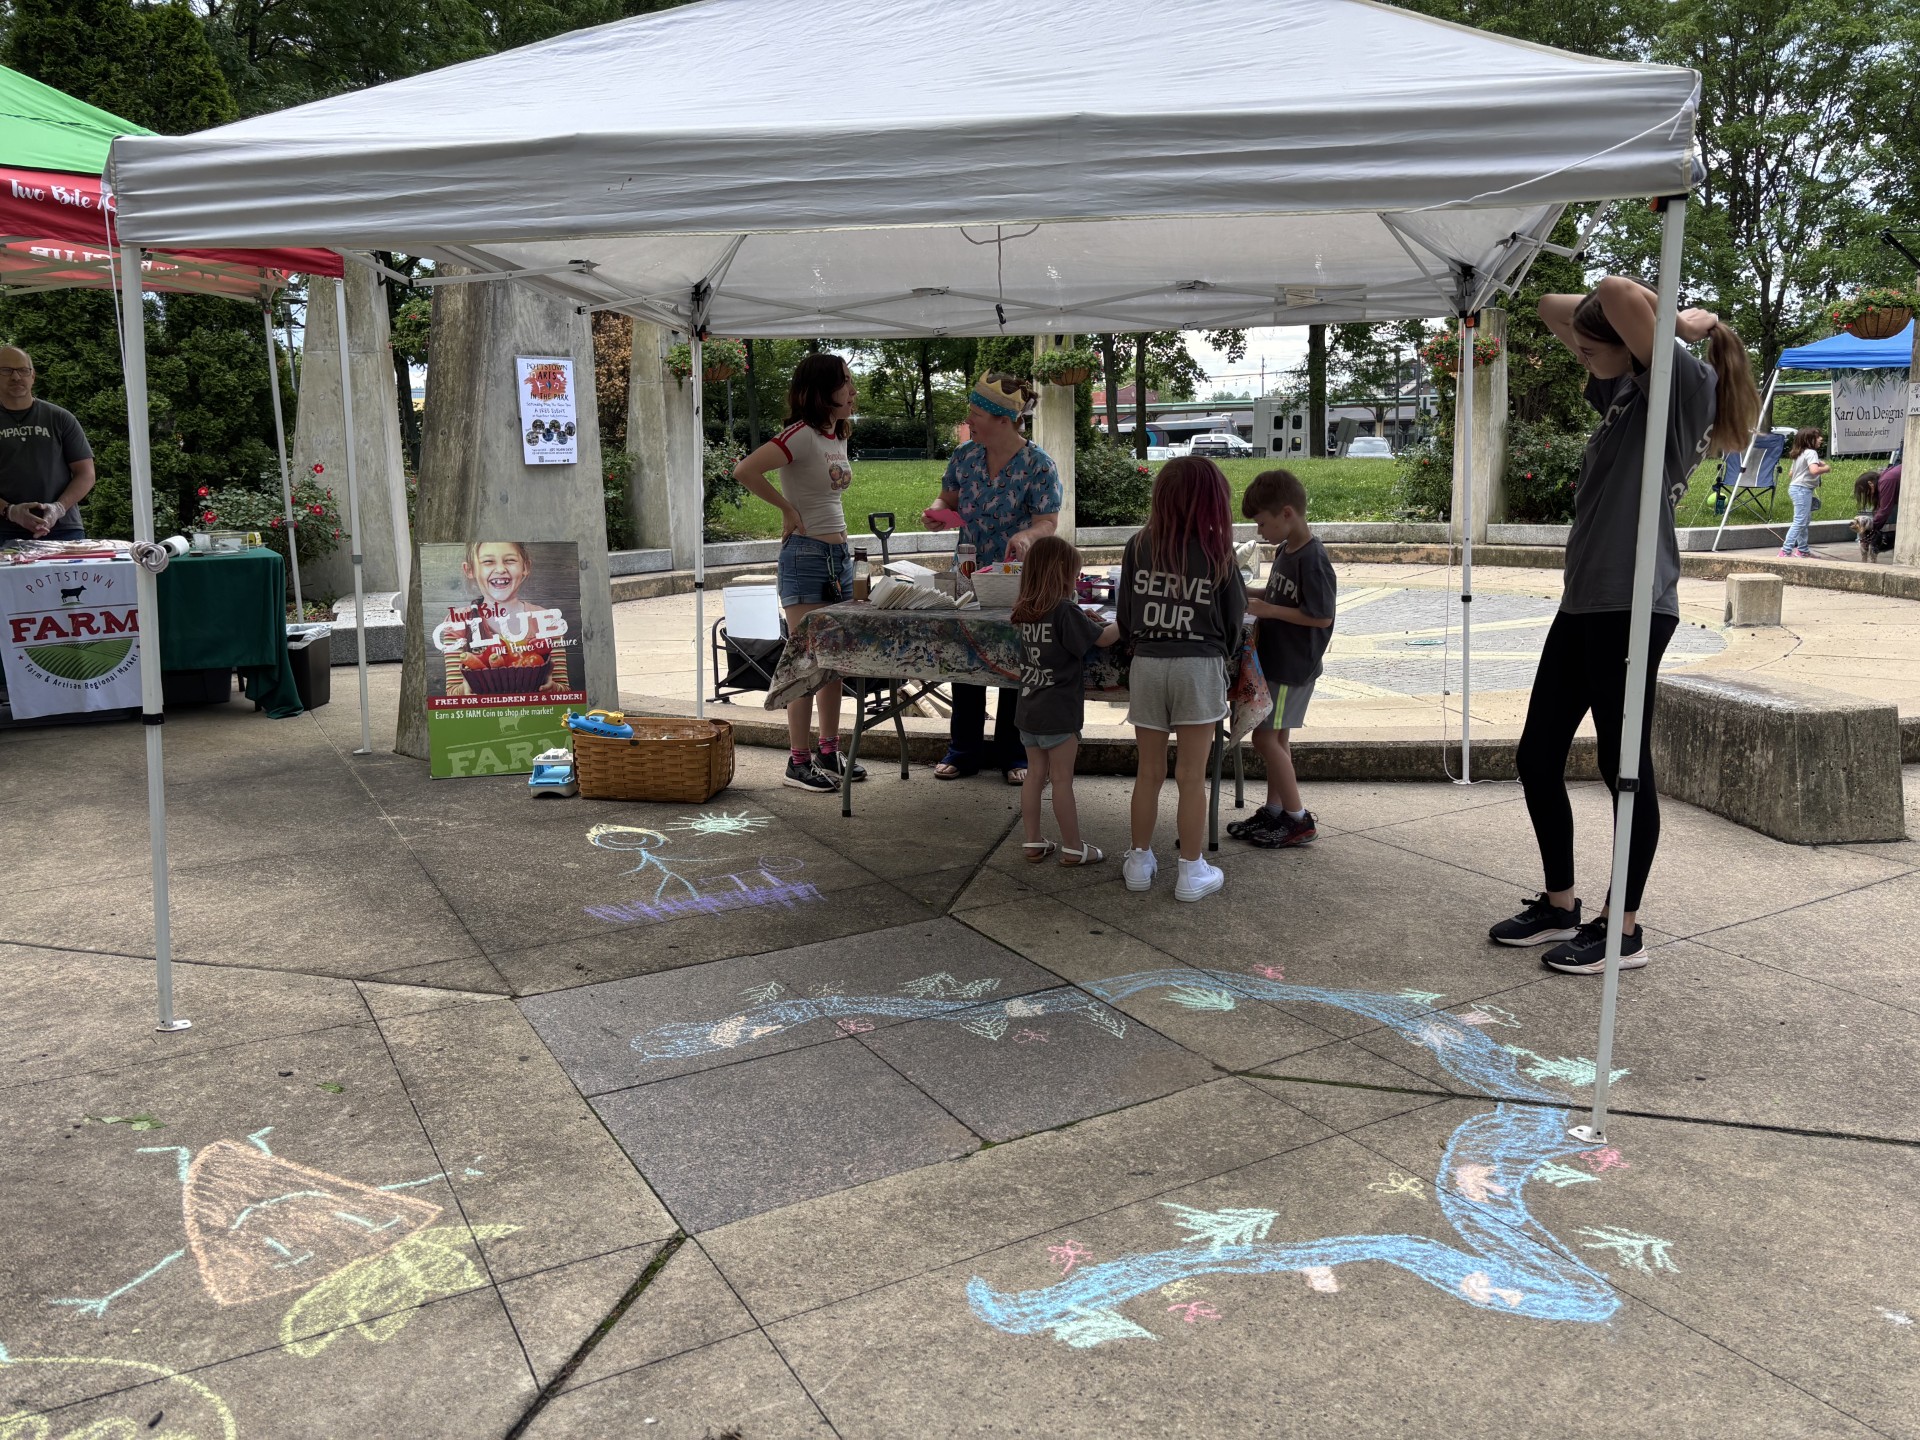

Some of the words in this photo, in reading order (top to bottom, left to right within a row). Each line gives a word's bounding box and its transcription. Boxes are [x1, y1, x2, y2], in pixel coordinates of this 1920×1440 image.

[8, 178, 46, 201] Two
[50, 185, 92, 208] Bite
[553, 393, 569, 401] PARK
[1835, 406, 1854, 420] Kari
[1857, 406, 1870, 420] On
[1873, 405, 1904, 423] Designs
[0, 425, 33, 438] MPACT
[35, 426, 50, 438] PA
[26, 571, 114, 594] POTTSTOWN
[1133, 569, 1211, 605] SERVE
[478, 601, 507, 619] Bite
[1143, 601, 1195, 632] OUR
[9, 609, 139, 643] FARM
[432, 608, 569, 652] CLUB
[25, 663, 42, 680] Farm
[44, 675, 51, 683] &
[53, 679, 82, 690] Artisan
[84, 672, 118, 690] Regional
[117, 653, 139, 675] Market
[1020, 663, 1055, 686] TATE
[435, 698, 459, 706] FREE
[461, 697, 479, 705] FOR
[480, 695, 526, 704] CHILDREN
[550, 693, 583, 701] UNDER!
[435, 711, 450, 720] Earn
[456, 710, 464, 719] $5
[465, 709, 481, 718] FARM
[482, 709, 496, 718] Coin
[504, 708, 519, 718] shop
[520, 707, 530, 716] the
[531, 706, 554, 716] market!
